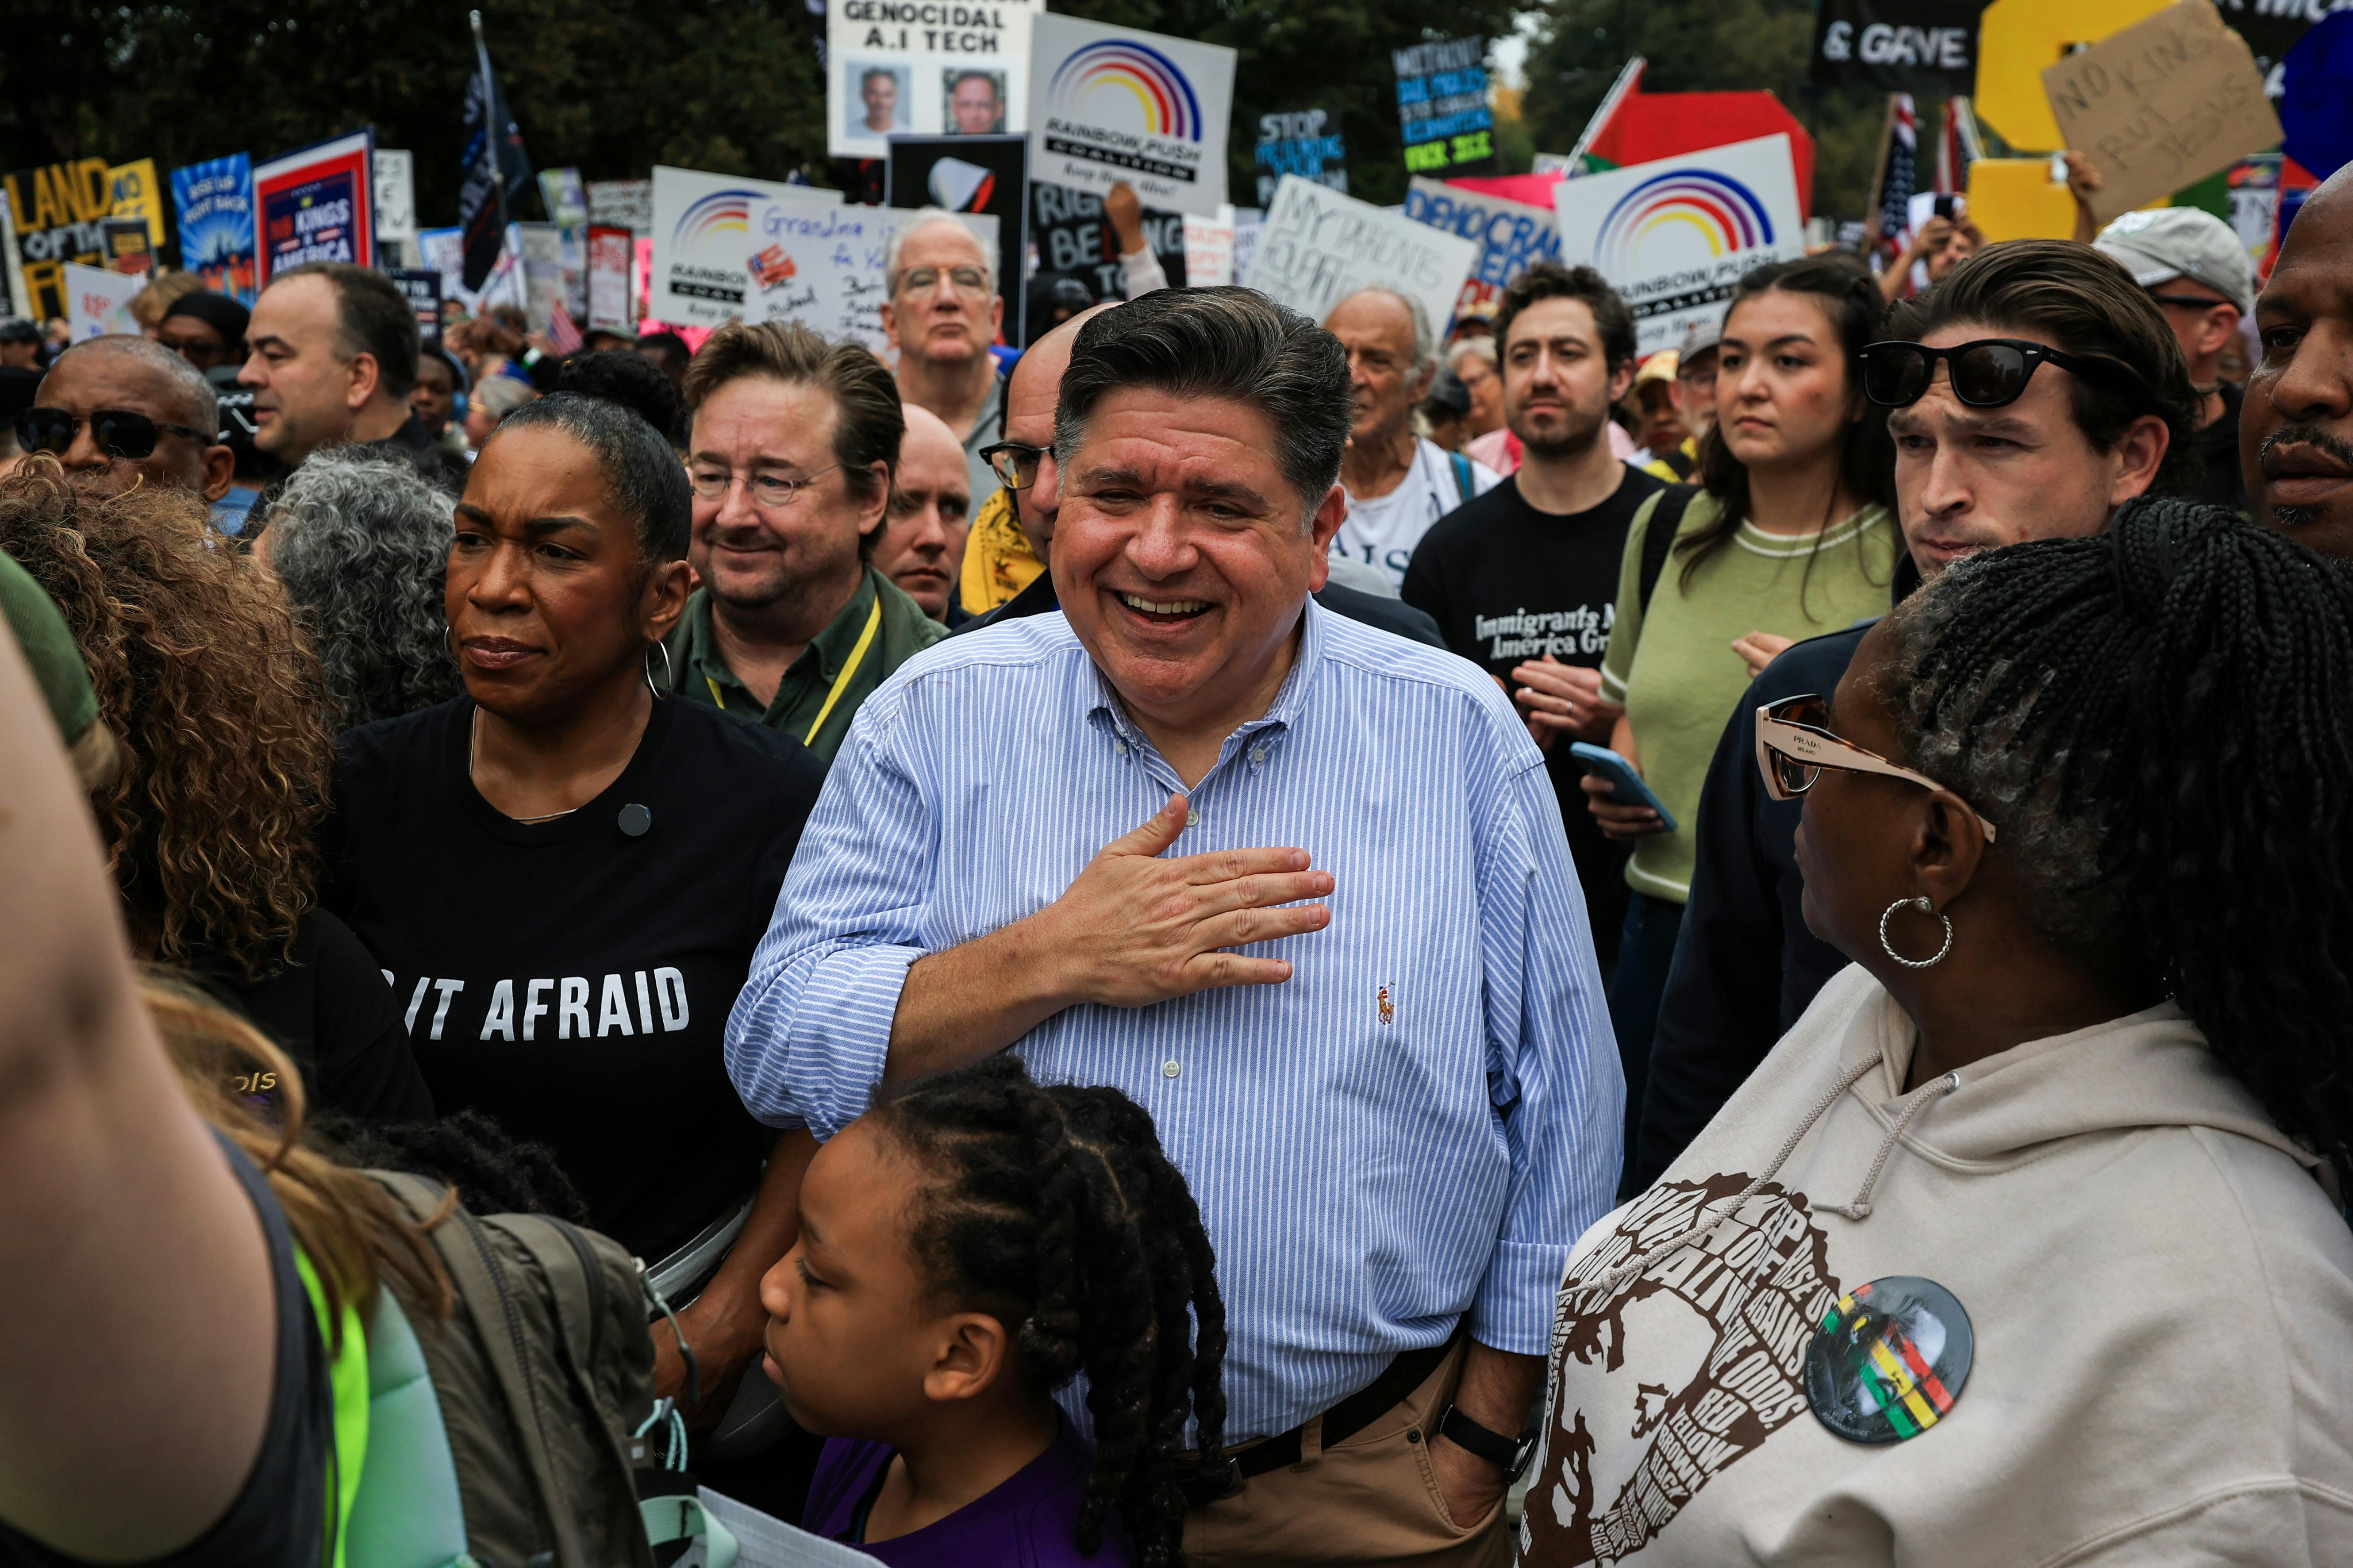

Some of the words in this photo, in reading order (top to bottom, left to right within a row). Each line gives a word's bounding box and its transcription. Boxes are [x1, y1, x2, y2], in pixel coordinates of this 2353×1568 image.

[844, 1, 1005, 29] GENOCIDAL
[923, 30, 999, 52] TECH
[1823, 20, 1853, 61] &
[1859, 23, 1969, 69] GAVE
[2056, 61, 2110, 119] NO
[1258, 108, 1327, 142] STOP
[4, 156, 112, 234] LAND
[295, 197, 350, 236] KINGS
[1034, 184, 1101, 226] RIG
[762, 204, 864, 240] Grandma
[1049, 217, 1184, 271] BELNG
[1406, 188, 1562, 265] DEMOCRA
[272, 238, 353, 274] AMERICA
[1617, 253, 1780, 302] AINBOW/PUSH
[677, 283, 746, 302] COAL
[1475, 603, 1600, 642] Immigrants
[1490, 631, 1577, 661] America
[1793, 735, 1822, 750] PRADA
[1797, 746, 1816, 756] MILANO
[480, 966, 689, 1041] AFRAID
[1704, 1194, 1808, 1249] KEEP
[1641, 1244, 1753, 1336] ALIVE
[1770, 1234, 1823, 1303] RISE
[1553, 1321, 1577, 1384] NEVER
[1709, 1315, 1758, 1380] THE
[1744, 1287, 1815, 1386] AGAINS
[1691, 1387, 1748, 1438] RED,
[1719, 1350, 1808, 1430] ODDS.
[1636, 1457, 1652, 1499] AND
[1649, 1449, 1688, 1500] BLACK
[1605, 1508, 1621, 1526] IN
[1606, 1518, 1630, 1557] GOD'S
[1620, 1495, 1642, 1547] PRECIOUS
